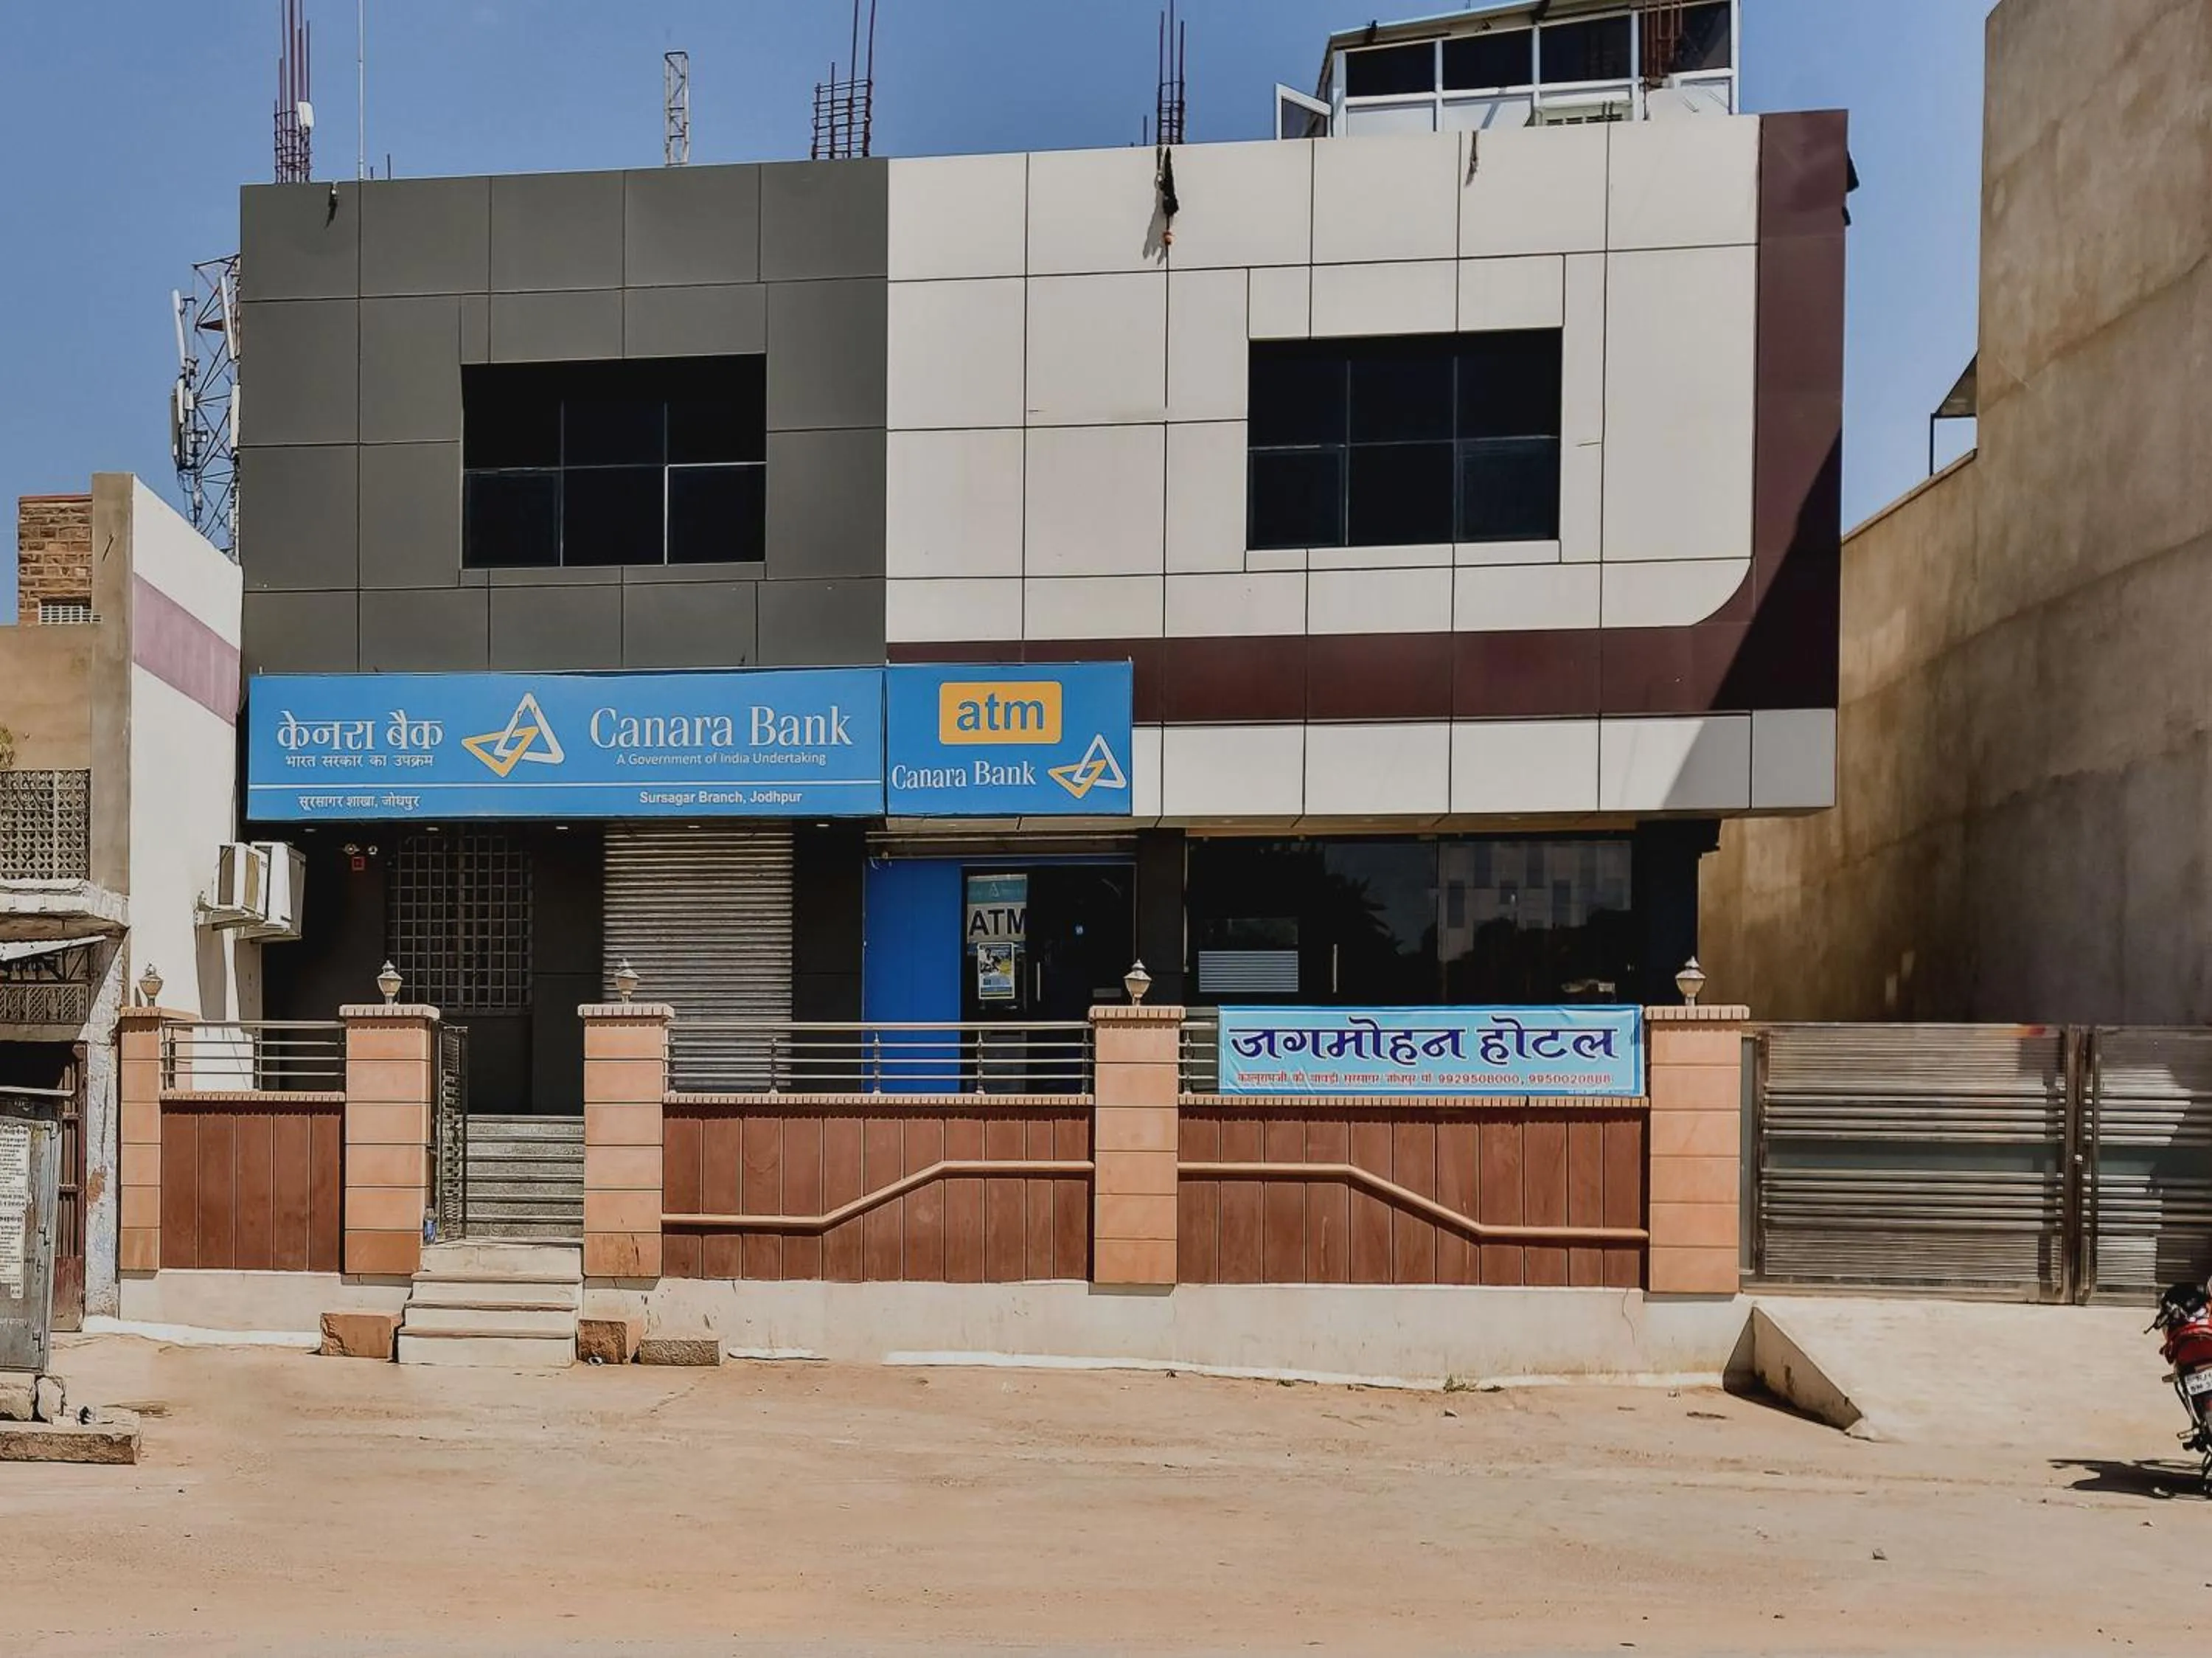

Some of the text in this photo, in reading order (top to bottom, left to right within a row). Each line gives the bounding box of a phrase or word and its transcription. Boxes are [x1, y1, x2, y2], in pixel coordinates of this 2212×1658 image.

[956, 692, 1045, 731] atm
[277, 710, 376, 750] केनरा
[590, 705, 853, 749] Canara Bank
[285, 754, 434, 768] भारत सरकार का उपक्रम
[616, 752, 826, 766] A Government of India Undertaking
[891, 760, 1037, 790] Canara Bank
[298, 795, 344, 811] सूरसागर
[381, 792, 420, 811] जोधपुर
[639, 790, 802, 806] Sursagar Branch, Jodhpur
[969, 908, 1026, 936] ATM
[1228, 1014, 1620, 1066] जगमोहन होटल
